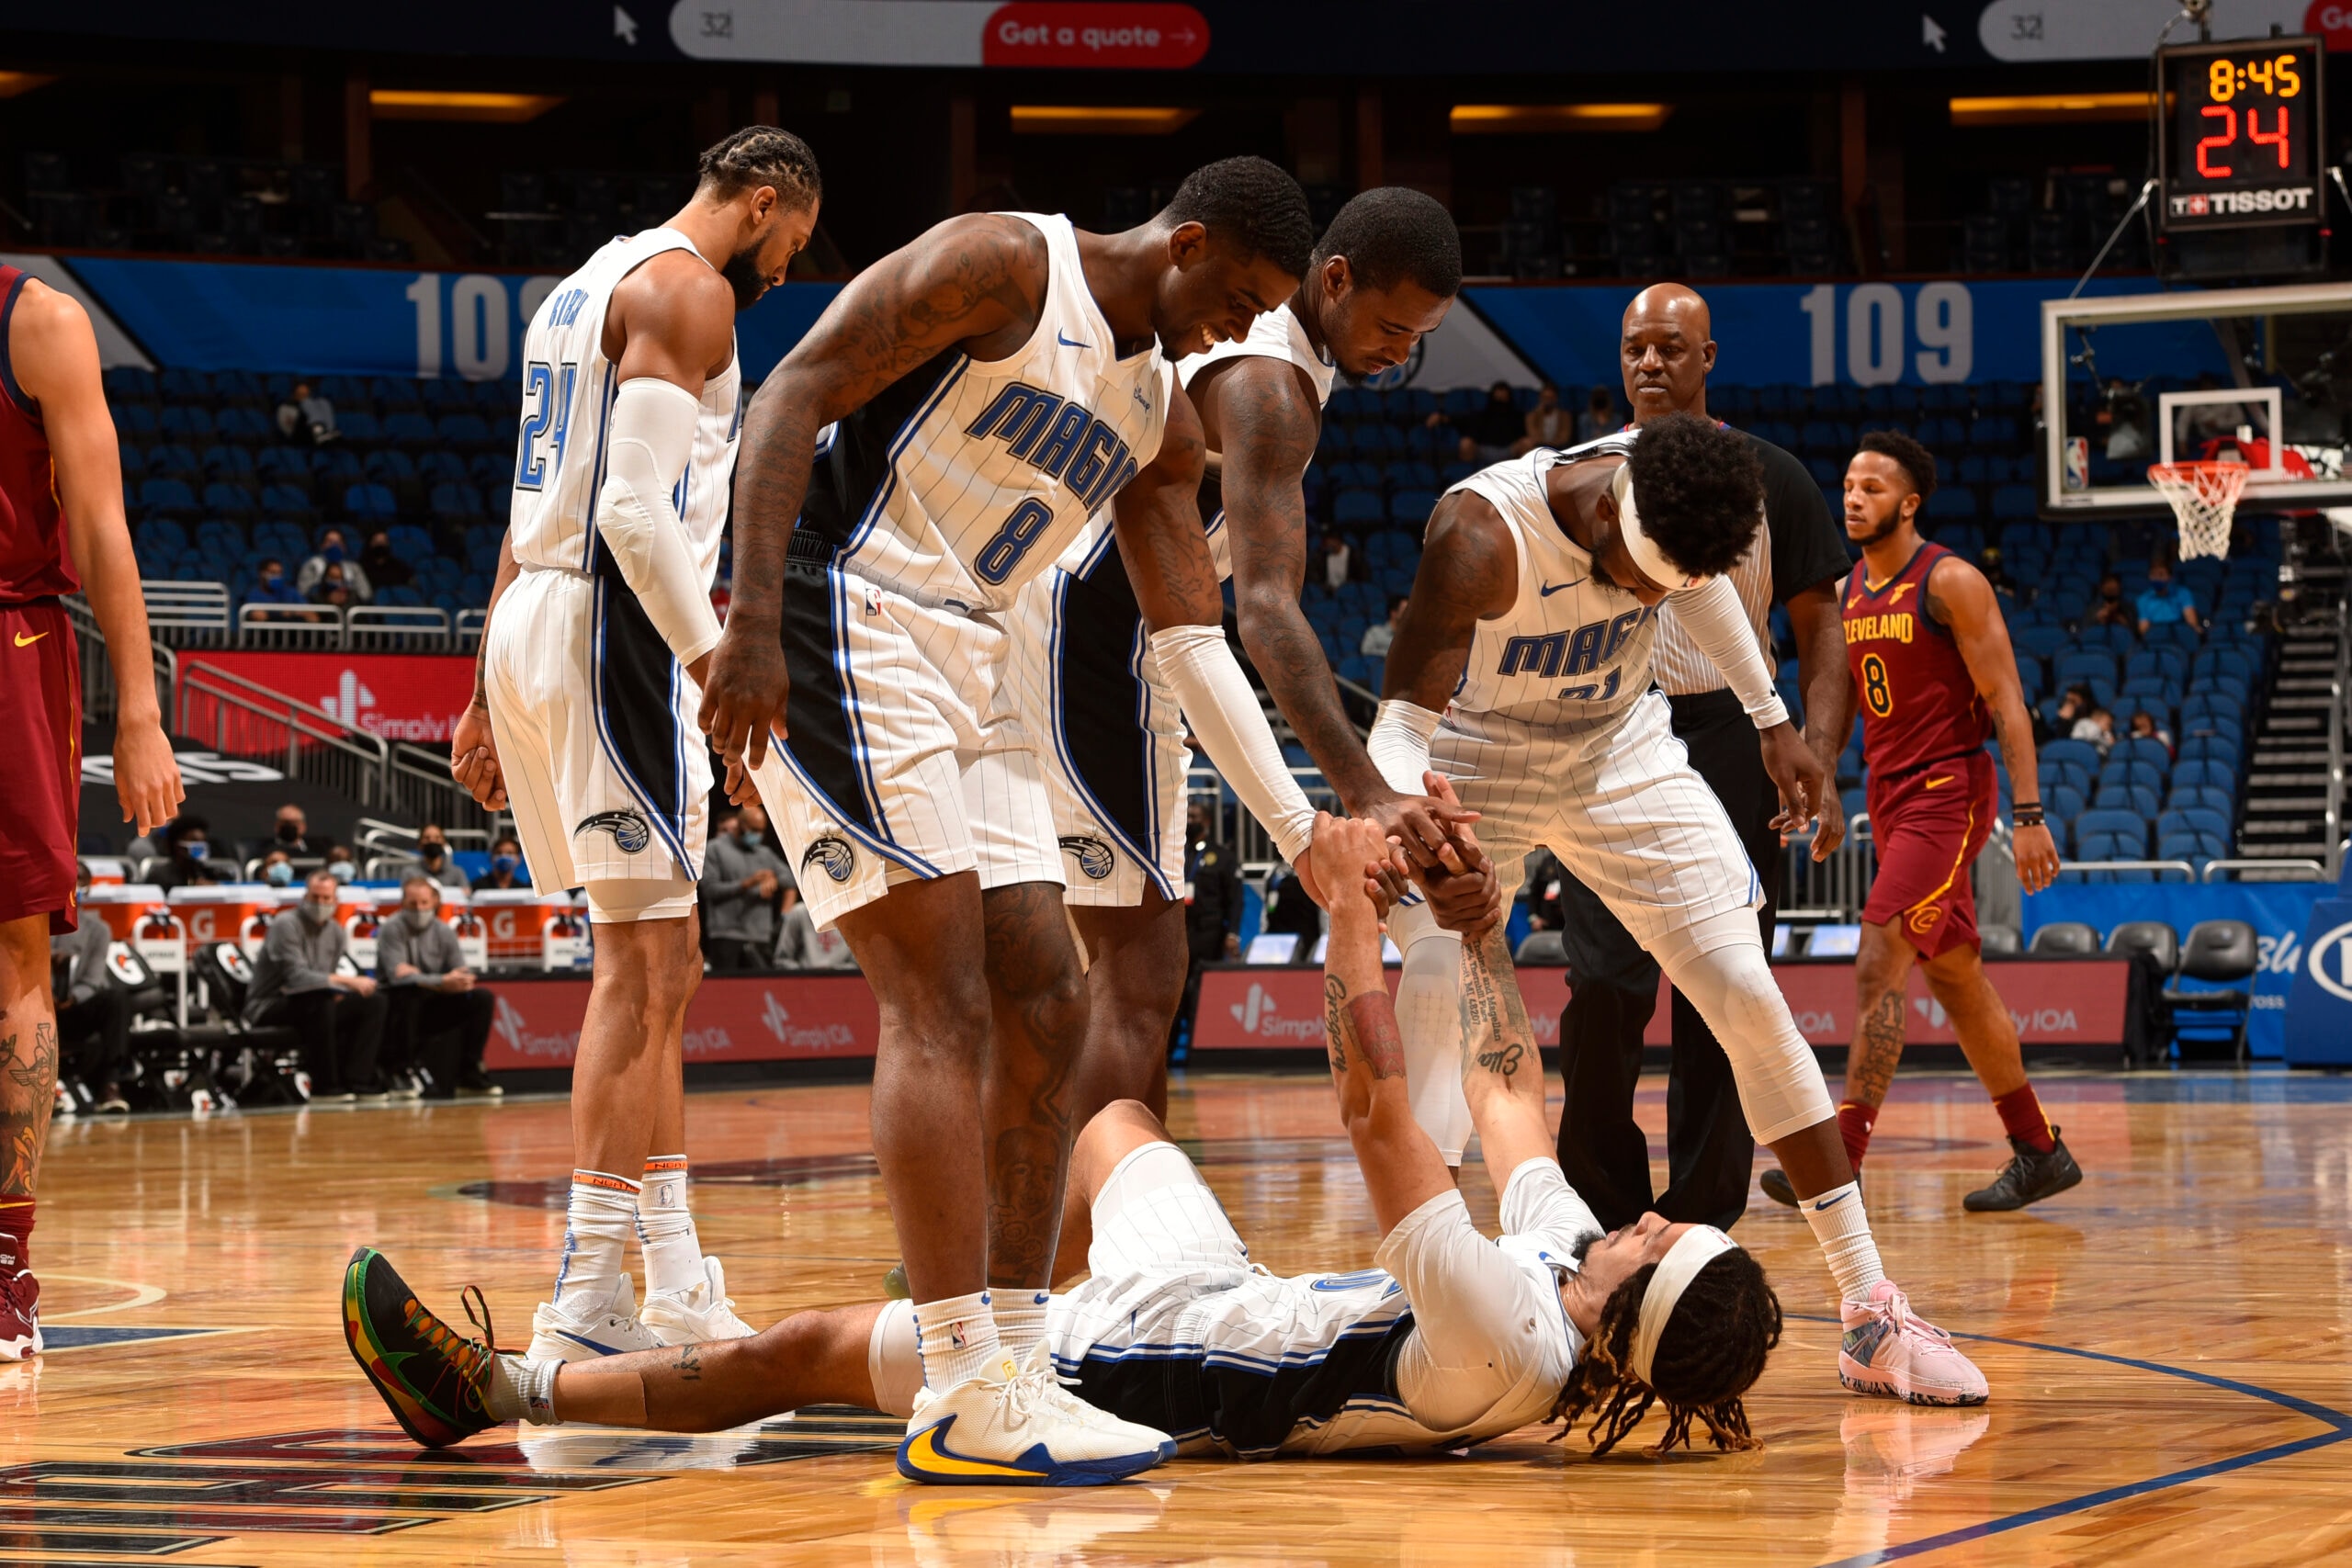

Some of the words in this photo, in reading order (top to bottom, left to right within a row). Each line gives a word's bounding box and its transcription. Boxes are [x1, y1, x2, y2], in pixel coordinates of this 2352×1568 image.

[700, 12, 732, 38] 32
[999, 21, 1049, 45] Get
[1056, 28, 1075, 45] a
[1081, 25, 1161, 51] quote
[2011, 14, 2042, 39] 32
[2321, 7, 2352, 31] Ge
[2209, 55, 2301, 102] 8:45
[2197, 106, 2289, 178] 24
[1800, 281, 1973, 388] 109
[516, 361, 577, 492] 24
[974, 497, 1054, 586] 8
[1498, 606, 1653, 678] MAG
[1843, 613, 1914, 645] LEVELAND
[1860, 653, 1894, 717] 8
[191, 909, 215, 942] G
[492, 910, 516, 940] G
[2256, 931, 2302, 974] Blu
[1325, 974, 1349, 1073] Gregory
[1487, 997, 1502, 1042] Magellan
[2033, 1010, 2078, 1032] IOA
[1477, 1043, 1524, 1076] Ella
